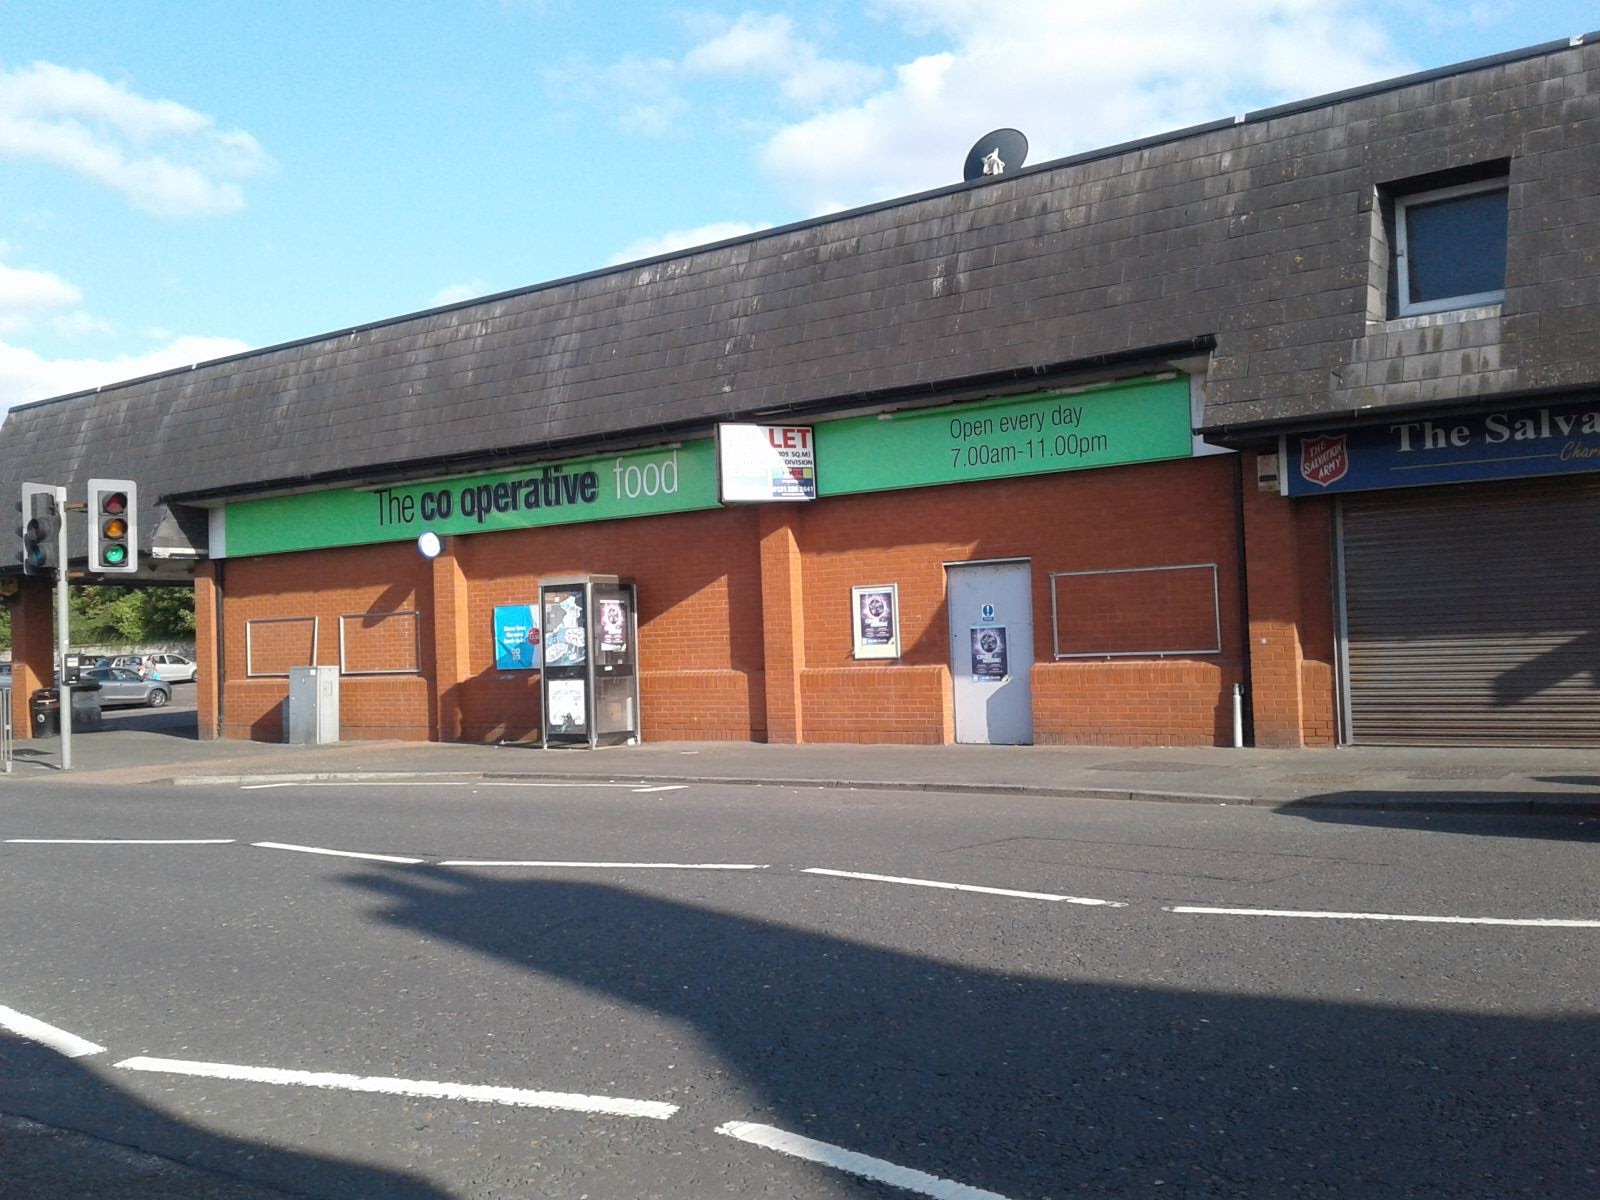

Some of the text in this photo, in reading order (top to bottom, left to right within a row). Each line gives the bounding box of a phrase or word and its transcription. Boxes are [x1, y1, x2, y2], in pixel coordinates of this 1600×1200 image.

[768, 428, 811, 448] LET
[950, 404, 1082, 441] Open every day
[1390, 421, 1471, 453] The
[951, 433, 1108, 468] 7.00am-11.00pm
[1304, 440, 1343, 475] SALVATION
[1309, 441, 1326, 458] THE
[1318, 456, 1342, 480] ARMY
[374, 449, 678, 526] The co operative food
